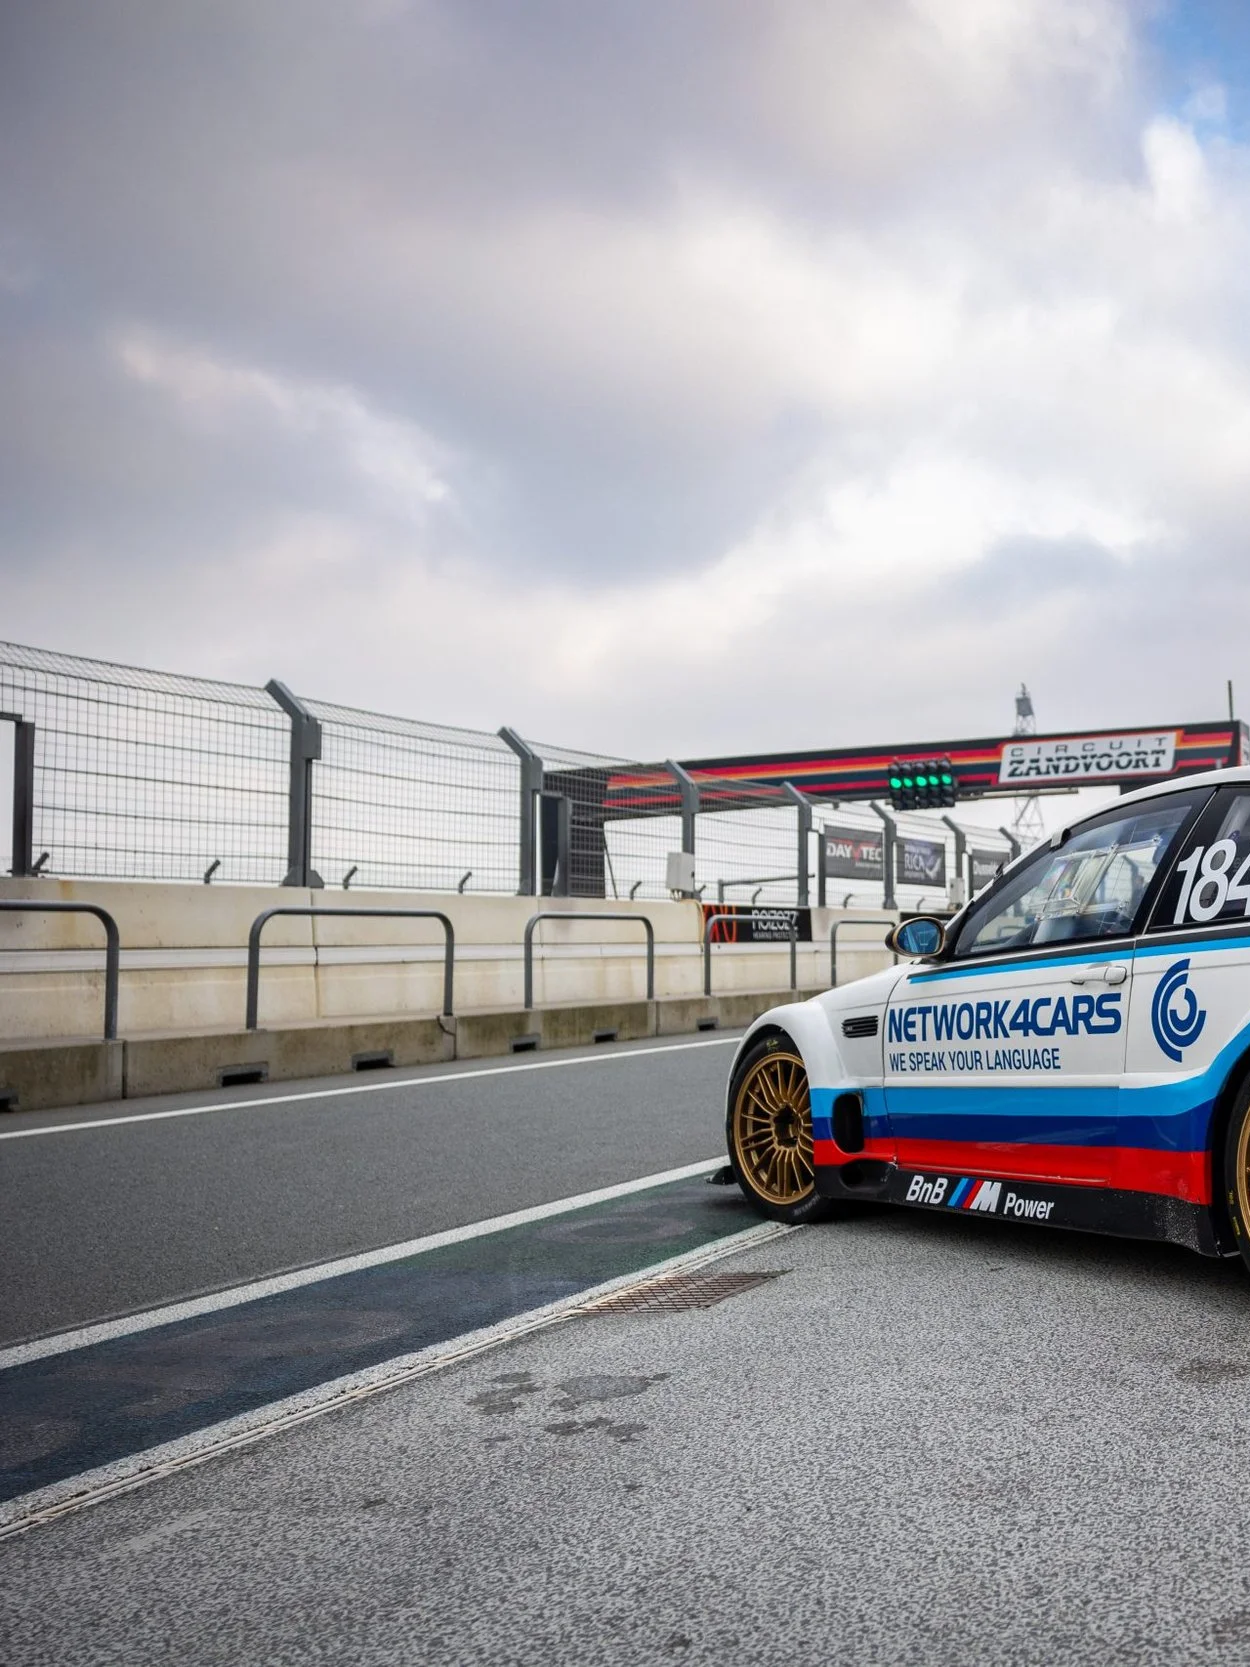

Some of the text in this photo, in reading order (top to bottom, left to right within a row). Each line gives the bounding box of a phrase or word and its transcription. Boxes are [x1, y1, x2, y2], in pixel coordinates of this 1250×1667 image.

[1010, 737, 1167, 757] CIRCUIT
[1007, 750, 1166, 778] ZANDVOORT
[888, 992, 1122, 1043] NETWORK4CARS
[889, 1048, 1061, 1072] WE SPEAK YOUR LANGUAGE
[905, 1174, 949, 1205] BnB
[1003, 1192, 1055, 1220] Power
